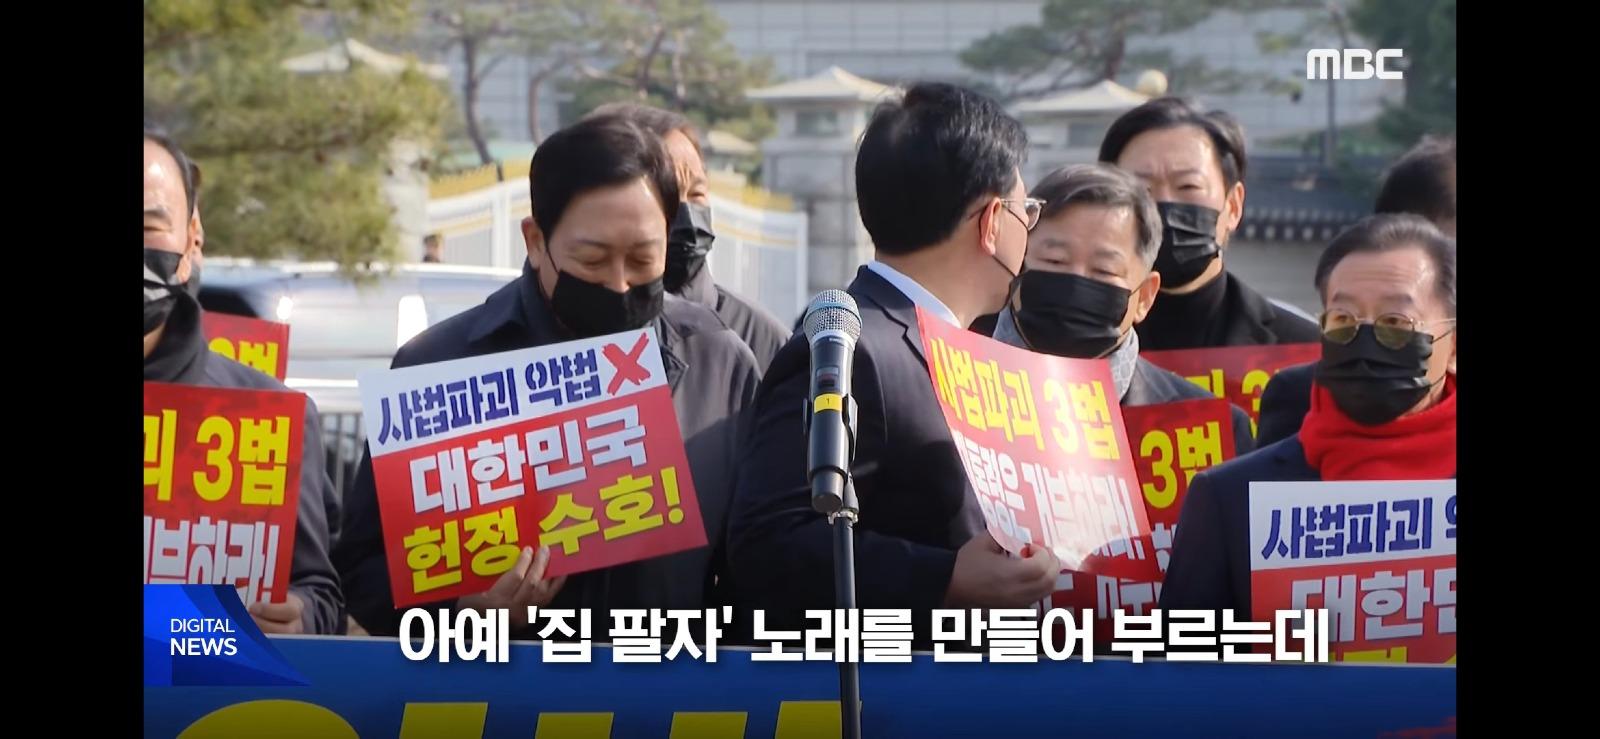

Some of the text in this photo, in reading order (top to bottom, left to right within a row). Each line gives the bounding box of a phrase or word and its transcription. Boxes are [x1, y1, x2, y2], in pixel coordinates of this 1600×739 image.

[378, 349, 602, 445] 사법파괴 악법
[930, 337, 1120, 460] 사법파괴 3법
[193, 416, 290, 505] 3법
[409, 405, 647, 514] 대한민국
[1140, 421, 1224, 510] 3법
[144, 516, 280, 605] 부하라!
[403, 466, 685, 594] 헌정 수호!
[1261, 498, 1433, 560] 사법파괴
